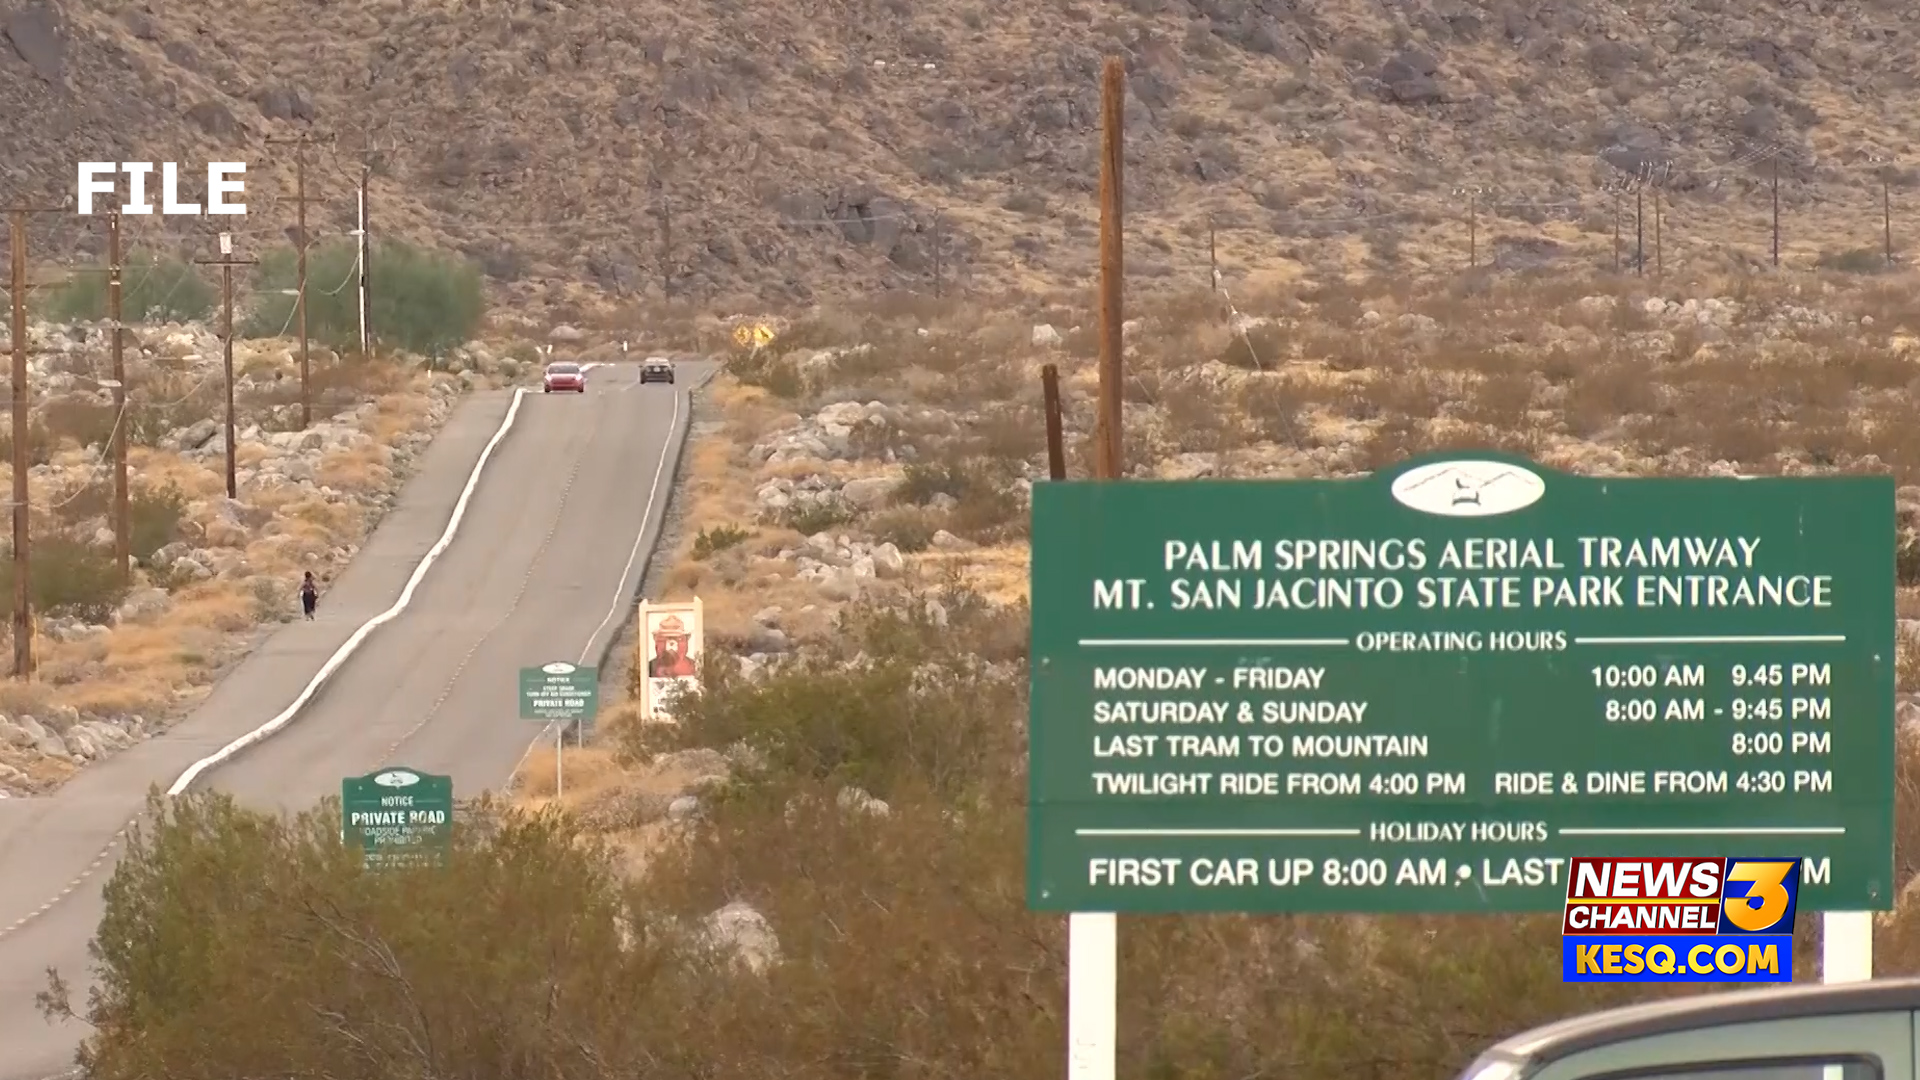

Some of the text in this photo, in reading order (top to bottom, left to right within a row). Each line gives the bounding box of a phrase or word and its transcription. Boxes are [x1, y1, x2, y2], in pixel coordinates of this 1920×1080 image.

[1164, 537, 1761, 571] PALM SPRINGS AERIAL TRAMWAY
[1093, 575, 1832, 610] MT. SAN JACINTO STATE PARK ENTRANCE
[1356, 630, 1567, 651] OPERATING HOURS
[1094, 666, 1207, 690] MONDAY
[1233, 666, 1326, 690] FRIDAY
[1592, 664, 1657, 688] 10:00
[1664, 664, 1705, 687] AM
[1791, 663, 1831, 686] PM
[1093, 700, 1230, 724] SATURDAY
[1236, 701, 1255, 724] &
[1262, 700, 1368, 724] SUNDAY
[1605, 699, 1657, 722] 8:00
[1664, 698, 1705, 720] AM
[1731, 698, 1783, 721] 9:45
[1791, 697, 1831, 720] PM
[1093, 731, 1831, 758] LAST TRAM TO MOUNTAIN 8:00 PM
[1091, 772, 1466, 795] TWILIGHT RIDE FROM 4:00 PM
[1495, 770, 1832, 795] RIDE & DINE FROM 4:30 PM
[381, 795, 414, 807] NOTICE
[351, 810, 446, 826] PRIVATE ROAD
[1370, 821, 1548, 842] HOLIDAY HOURS
[1089, 857, 1831, 887] FIRST CAR UP 8:00 AM LAST M
